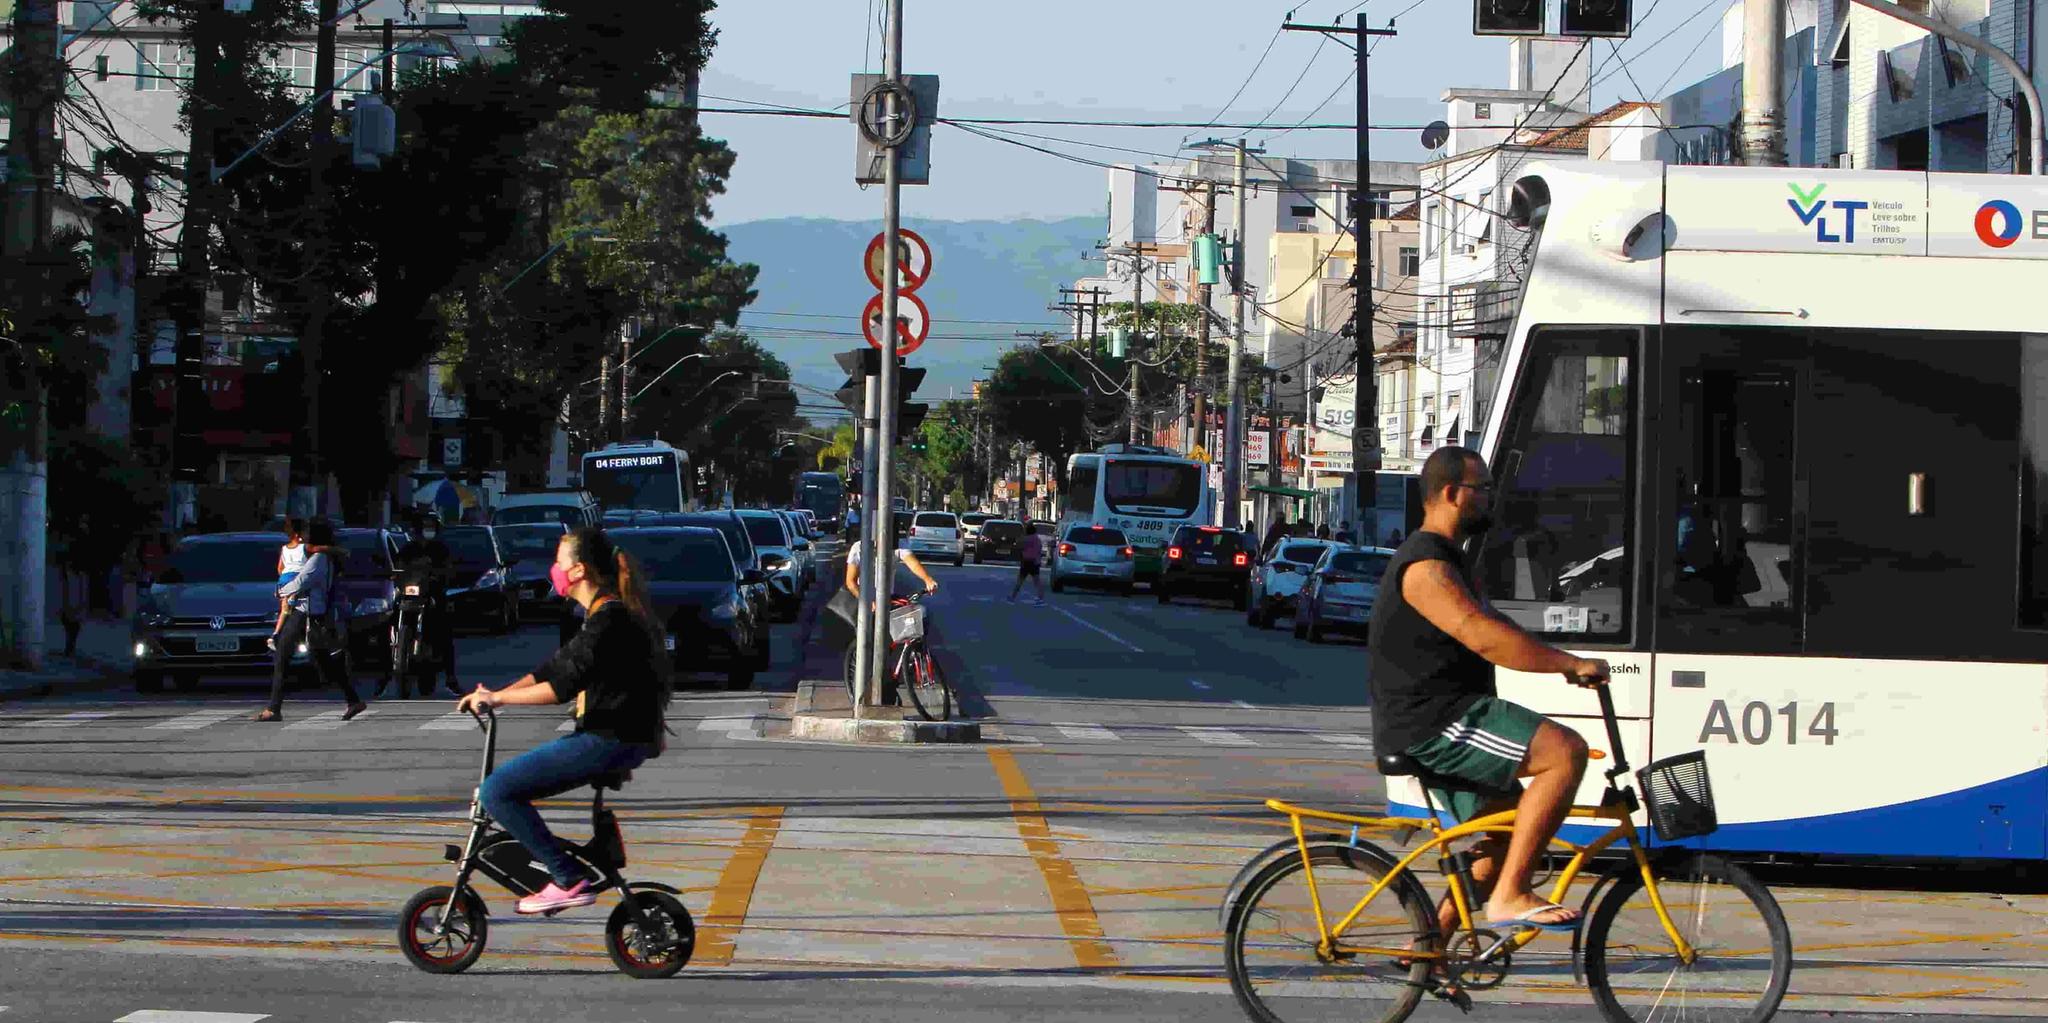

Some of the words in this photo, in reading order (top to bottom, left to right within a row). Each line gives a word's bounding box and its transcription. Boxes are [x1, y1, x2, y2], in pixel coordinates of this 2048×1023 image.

[1787, 198, 1868, 243] VLT
[1872, 213, 1891, 221] Leve
[1893, 213, 1917, 221] sobre
[1872, 225, 1900, 233] Trilhos
[1325, 408, 1355, 425] 519
[596, 460, 608, 468] 04
[610, 458, 639, 468] FERRY
[1137, 520, 1163, 531] 4809
[1698, 699, 1839, 746] A014
